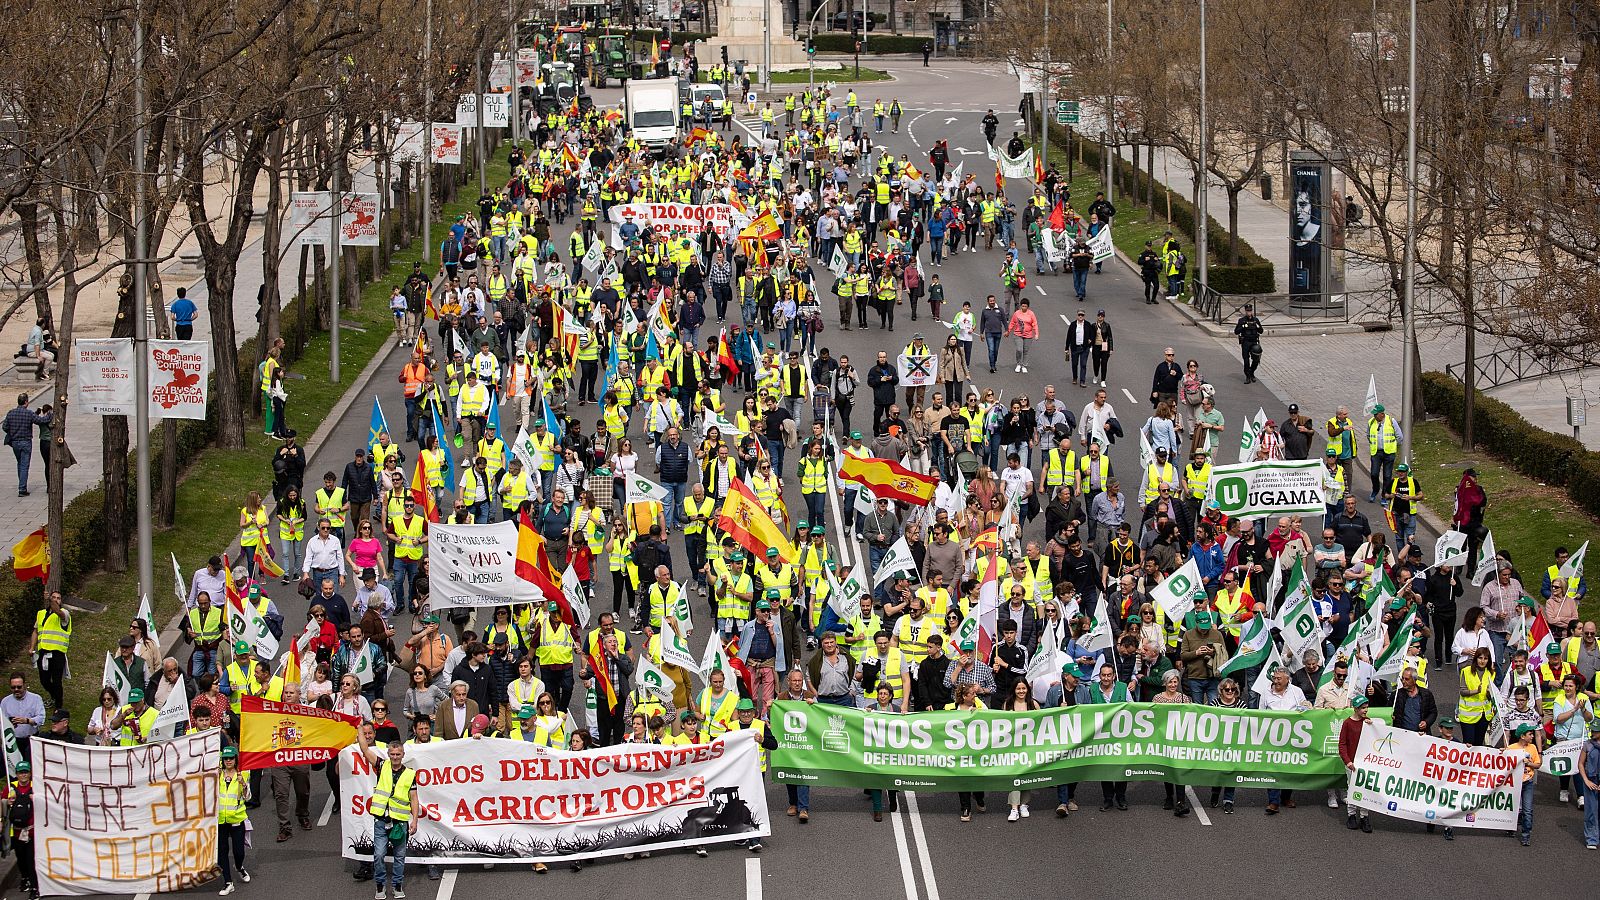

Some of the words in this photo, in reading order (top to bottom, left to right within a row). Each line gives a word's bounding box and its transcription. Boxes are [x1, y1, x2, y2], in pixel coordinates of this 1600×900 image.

[484, 96, 504, 104] CUL
[461, 105, 476, 113] RID
[487, 105, 500, 113] TU
[494, 113, 507, 121] RA
[651, 205, 715, 220] 120.000
[654, 224, 671, 232] OR
[155, 352, 201, 362] Stephanie
[157, 361, 201, 371] Comilang
[155, 386, 169, 394] EN
[170, 386, 203, 395] BUSCA
[153, 394, 166, 403] DE
[167, 394, 181, 402] LA
[182, 395, 204, 404] VIDA
[1223, 484, 1241, 505] u
[1249, 490, 1322, 506] UGAMA
[436, 533, 450, 543] POR
[469, 552, 501, 567] VIVO
[450, 572, 463, 582] SIN
[469, 572, 502, 583] LIMOSNAS
[910, 626, 921, 634] US
[262, 700, 280, 711] EL
[863, 717, 933, 750] NOS
[944, 713, 1082, 750] SOBRAN
[1092, 709, 1155, 741] LOS
[1165, 710, 1313, 749] MOTIVOS
[784, 733, 807, 742] Unión
[786, 742, 814, 751] Uniones
[274, 749, 332, 763] CUENCA
[863, 751, 956, 768] DEFENDEMOS
[960, 755, 976, 768] EL
[980, 752, 1031, 768] CAMPO,
[1035, 742, 1121, 764] DEFENDEMOS
[1126, 742, 1141, 756] LA
[1146, 742, 1241, 764] ALIMENTACIÓN
[1245, 750, 1262, 763] DE
[1265, 751, 1309, 765] TODOS
[1364, 753, 1403, 769] ADECCU
[1426, 743, 1517, 771] ASOCIACIÓN
[416, 764, 485, 787] OMOS
[499, 740, 725, 782] DELINCUENTES
[1422, 761, 1445, 781] EN
[1446, 769, 1515, 789] DEFENSA
[1354, 768, 1381, 793] DEL
[1384, 775, 1436, 805] CAMPO
[1438, 788, 1459, 810] DE
[1460, 791, 1514, 812] CUENCA
[43, 781, 138, 832] MUERE
[148, 772, 218, 826] 2030
[351, 794, 442, 822] SOS
[452, 776, 705, 823] AGRICULTORES
[45, 837, 92, 881] EL
